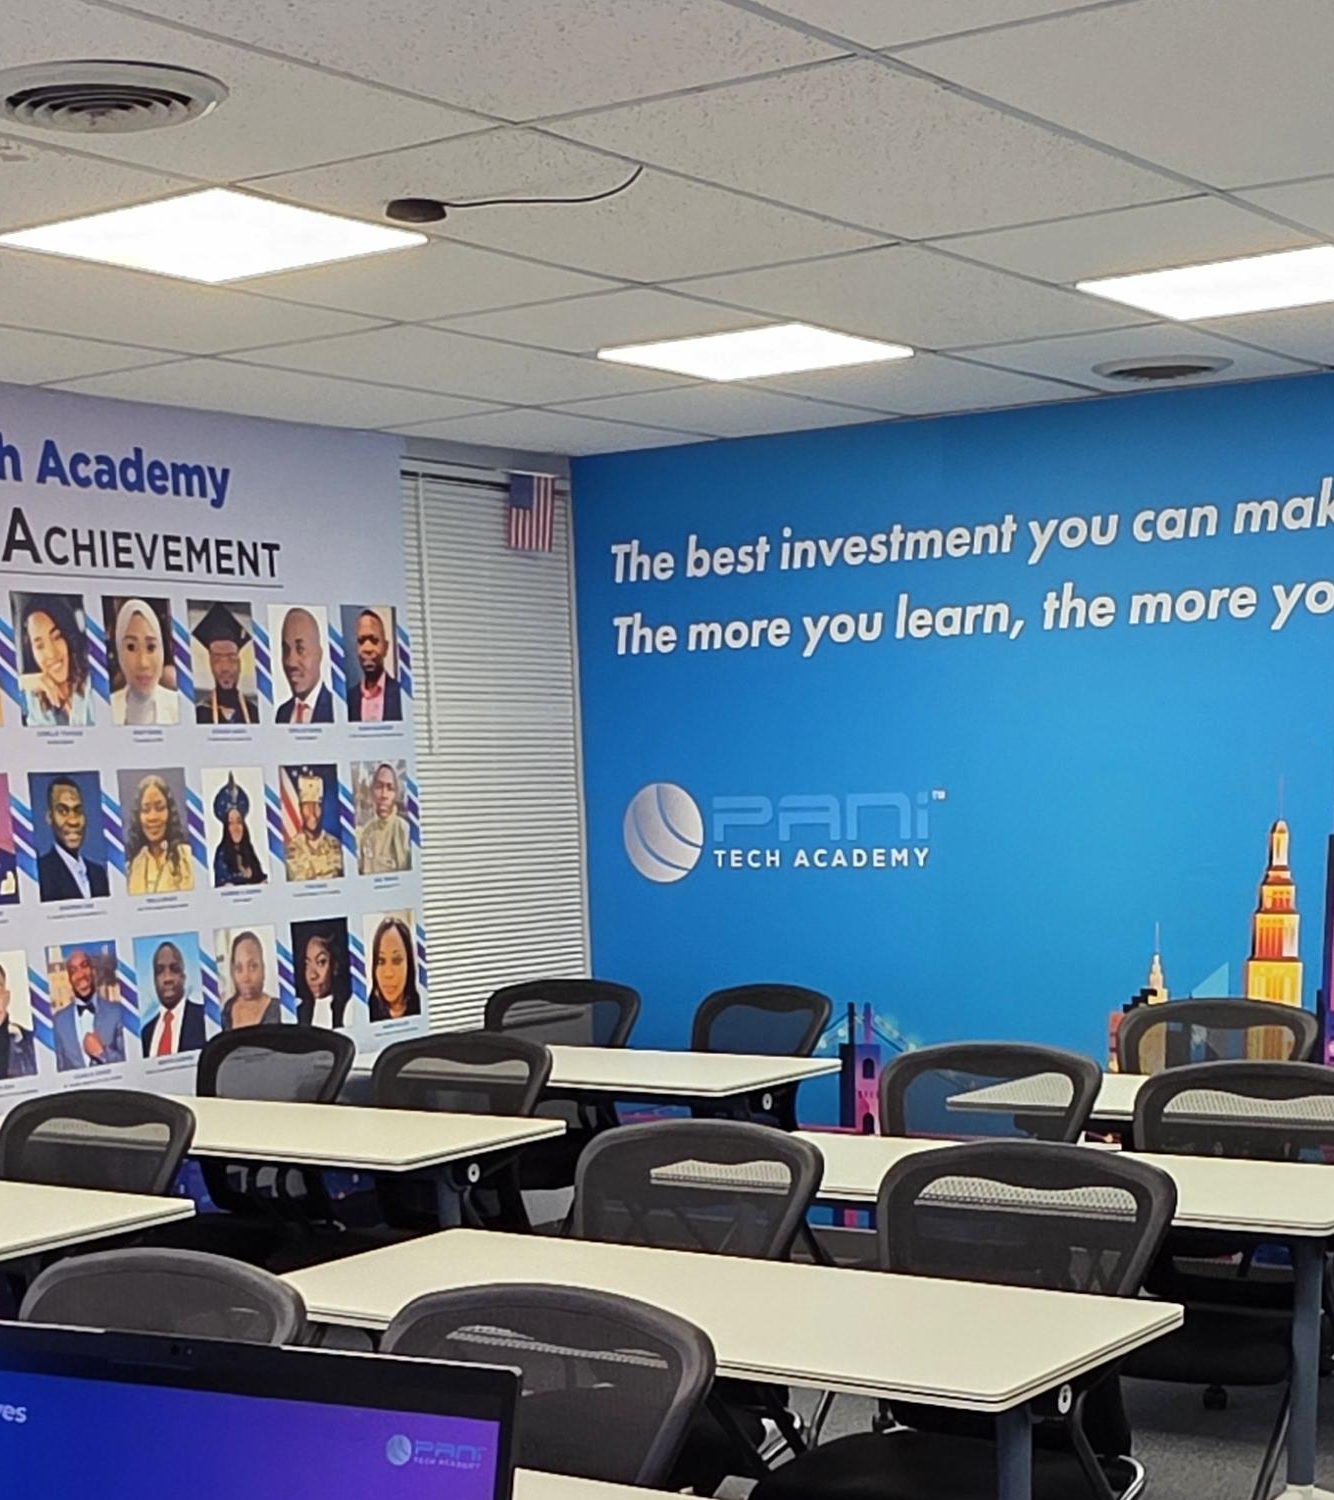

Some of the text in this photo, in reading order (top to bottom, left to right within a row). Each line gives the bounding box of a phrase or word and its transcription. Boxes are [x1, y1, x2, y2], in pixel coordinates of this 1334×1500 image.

[37, 440, 230, 507] Academy
[612, 538, 675, 583] The
[686, 532, 770, 578] best
[780, 514, 1019, 572] investment
[1028, 513, 1119, 565] you
[1132, 505, 1218, 542] can
[614, 613, 677, 655] The
[687, 617, 791, 651] more
[802, 611, 884, 658] you
[894, 594, 1025, 640] learn,
[1042, 581, 1116, 630] the
[1128, 585, 1257, 625] more
[714, 848, 929, 868] TECH ACADEMY
